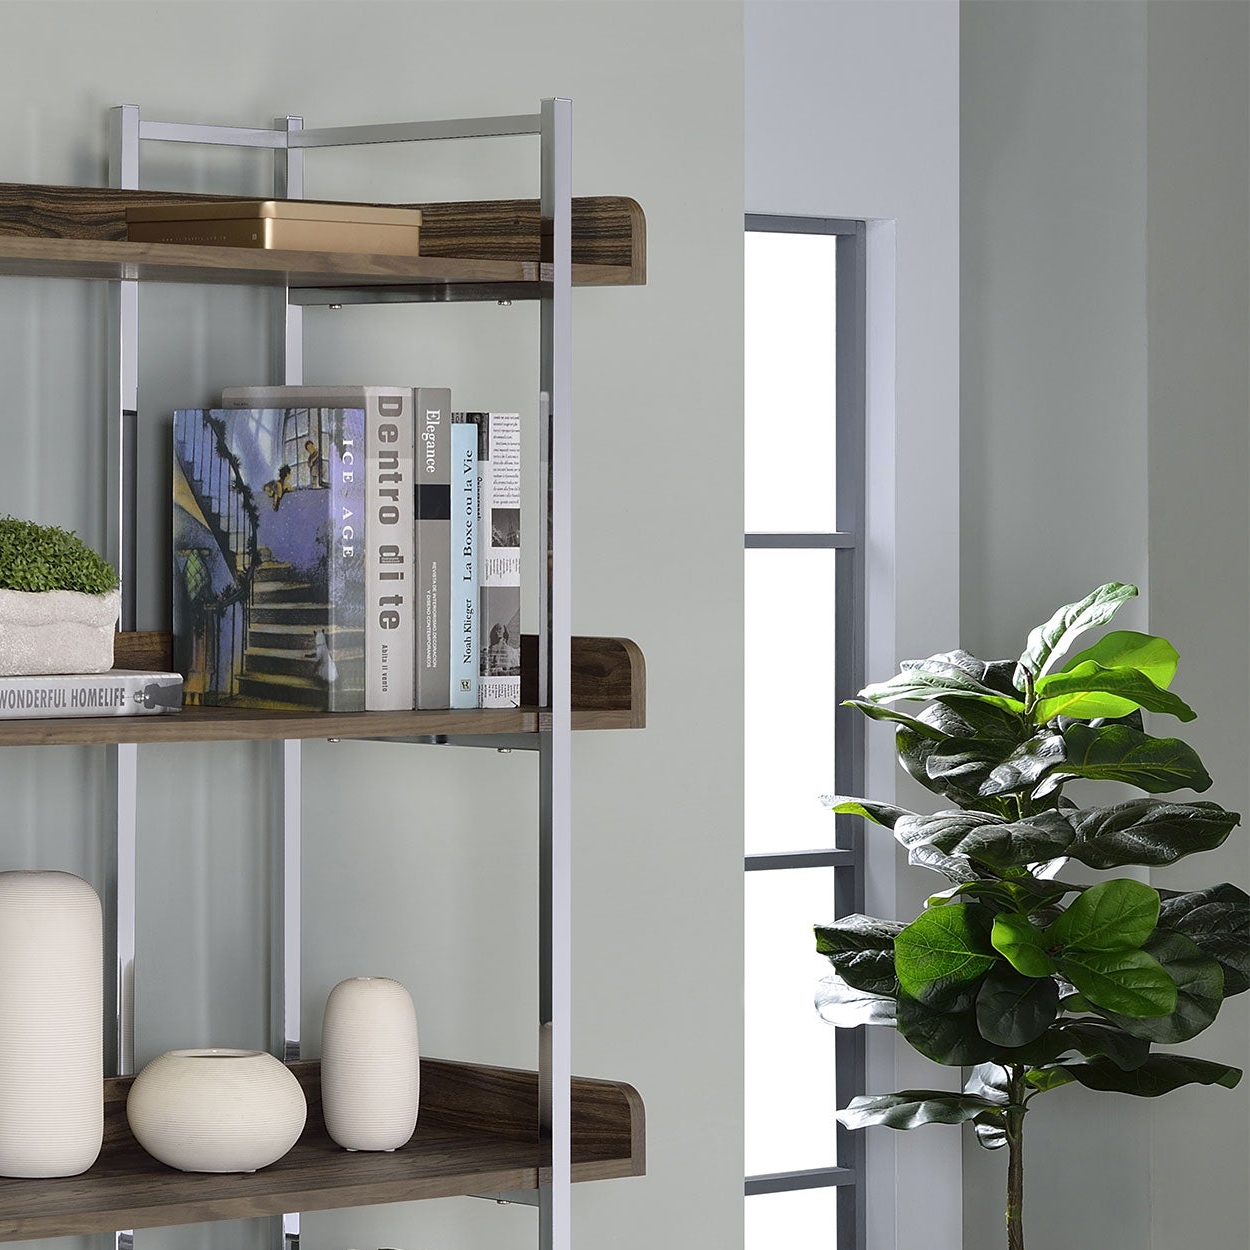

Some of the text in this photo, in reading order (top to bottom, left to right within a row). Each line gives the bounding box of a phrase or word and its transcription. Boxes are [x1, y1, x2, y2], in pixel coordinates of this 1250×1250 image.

[377, 395, 403, 525] Dentro
[422, 409, 441, 473] Elegance
[342, 438, 354, 559] ICE AGE
[378, 544, 405, 581] di
[463, 449, 474, 664] Noah Klieger La Boxe ou la Vie
[378, 593, 404, 630] te
[70, 687, 126, 709] HOMELIFE
